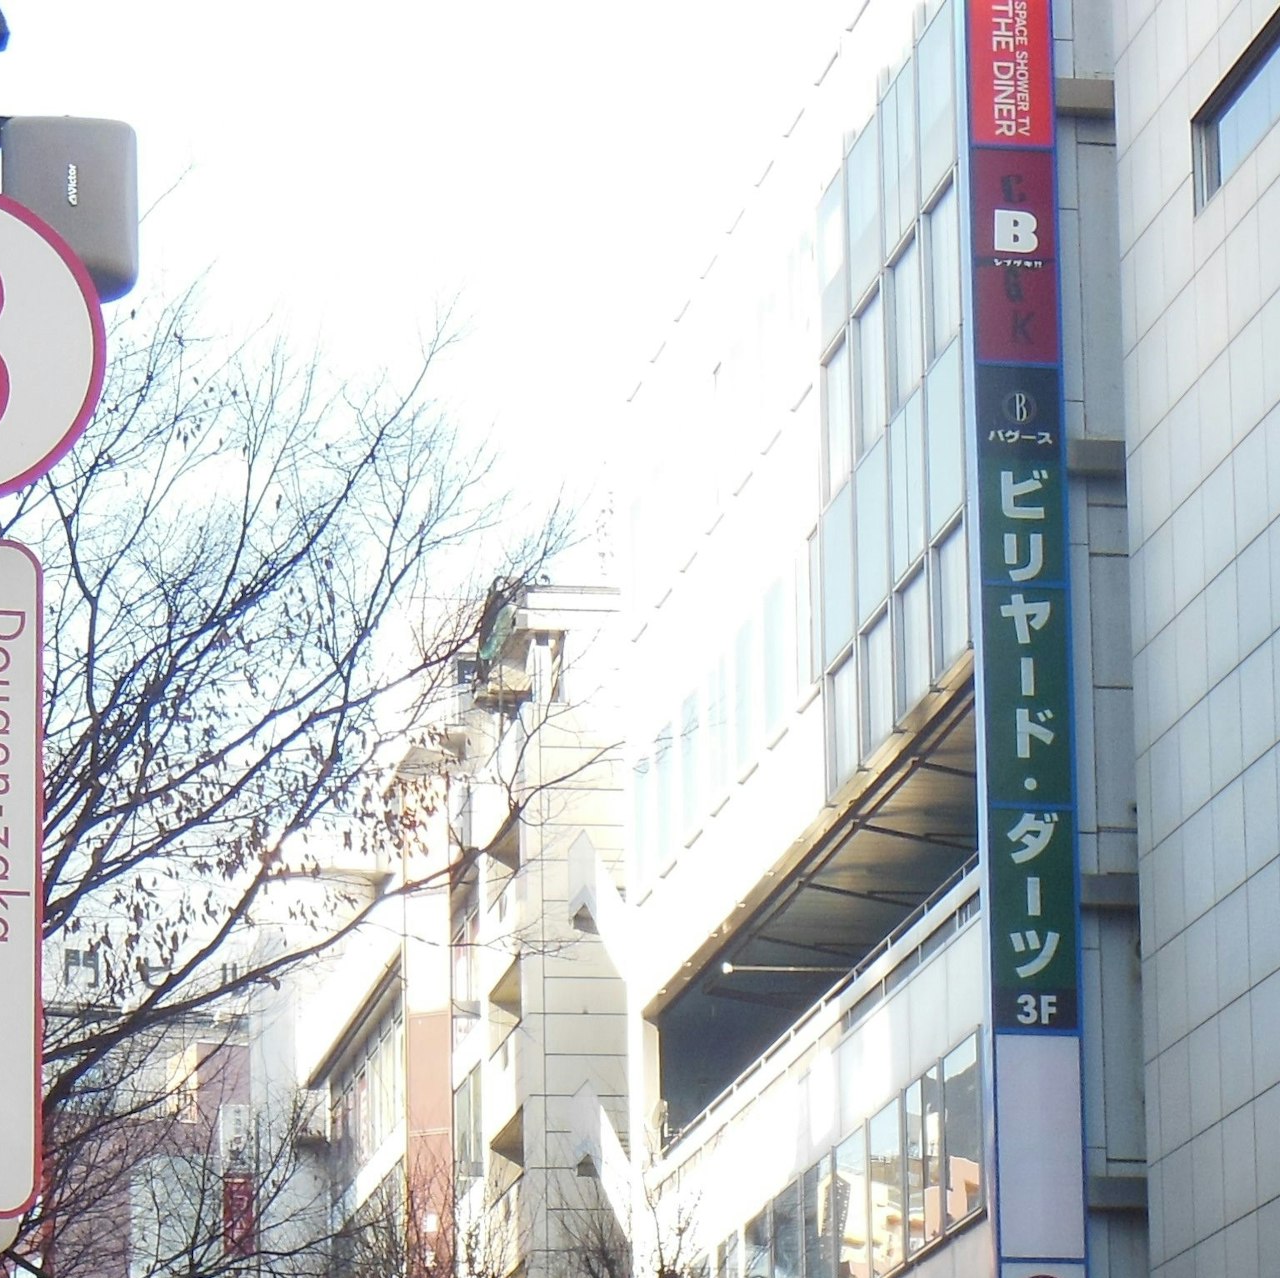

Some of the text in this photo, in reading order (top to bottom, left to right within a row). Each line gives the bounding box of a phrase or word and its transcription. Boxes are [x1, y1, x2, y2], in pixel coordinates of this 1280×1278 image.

[991, 3, 1016, 136] THE DINER
[1015, 51, 1030, 112] SHOWER
[1017, 117, 1031, 136] TV
[993, 208, 1039, 253] B
[1000, 469, 1061, 979] ビリヤード・ダーツ
[1016, 994, 1057, 1026] 3F
